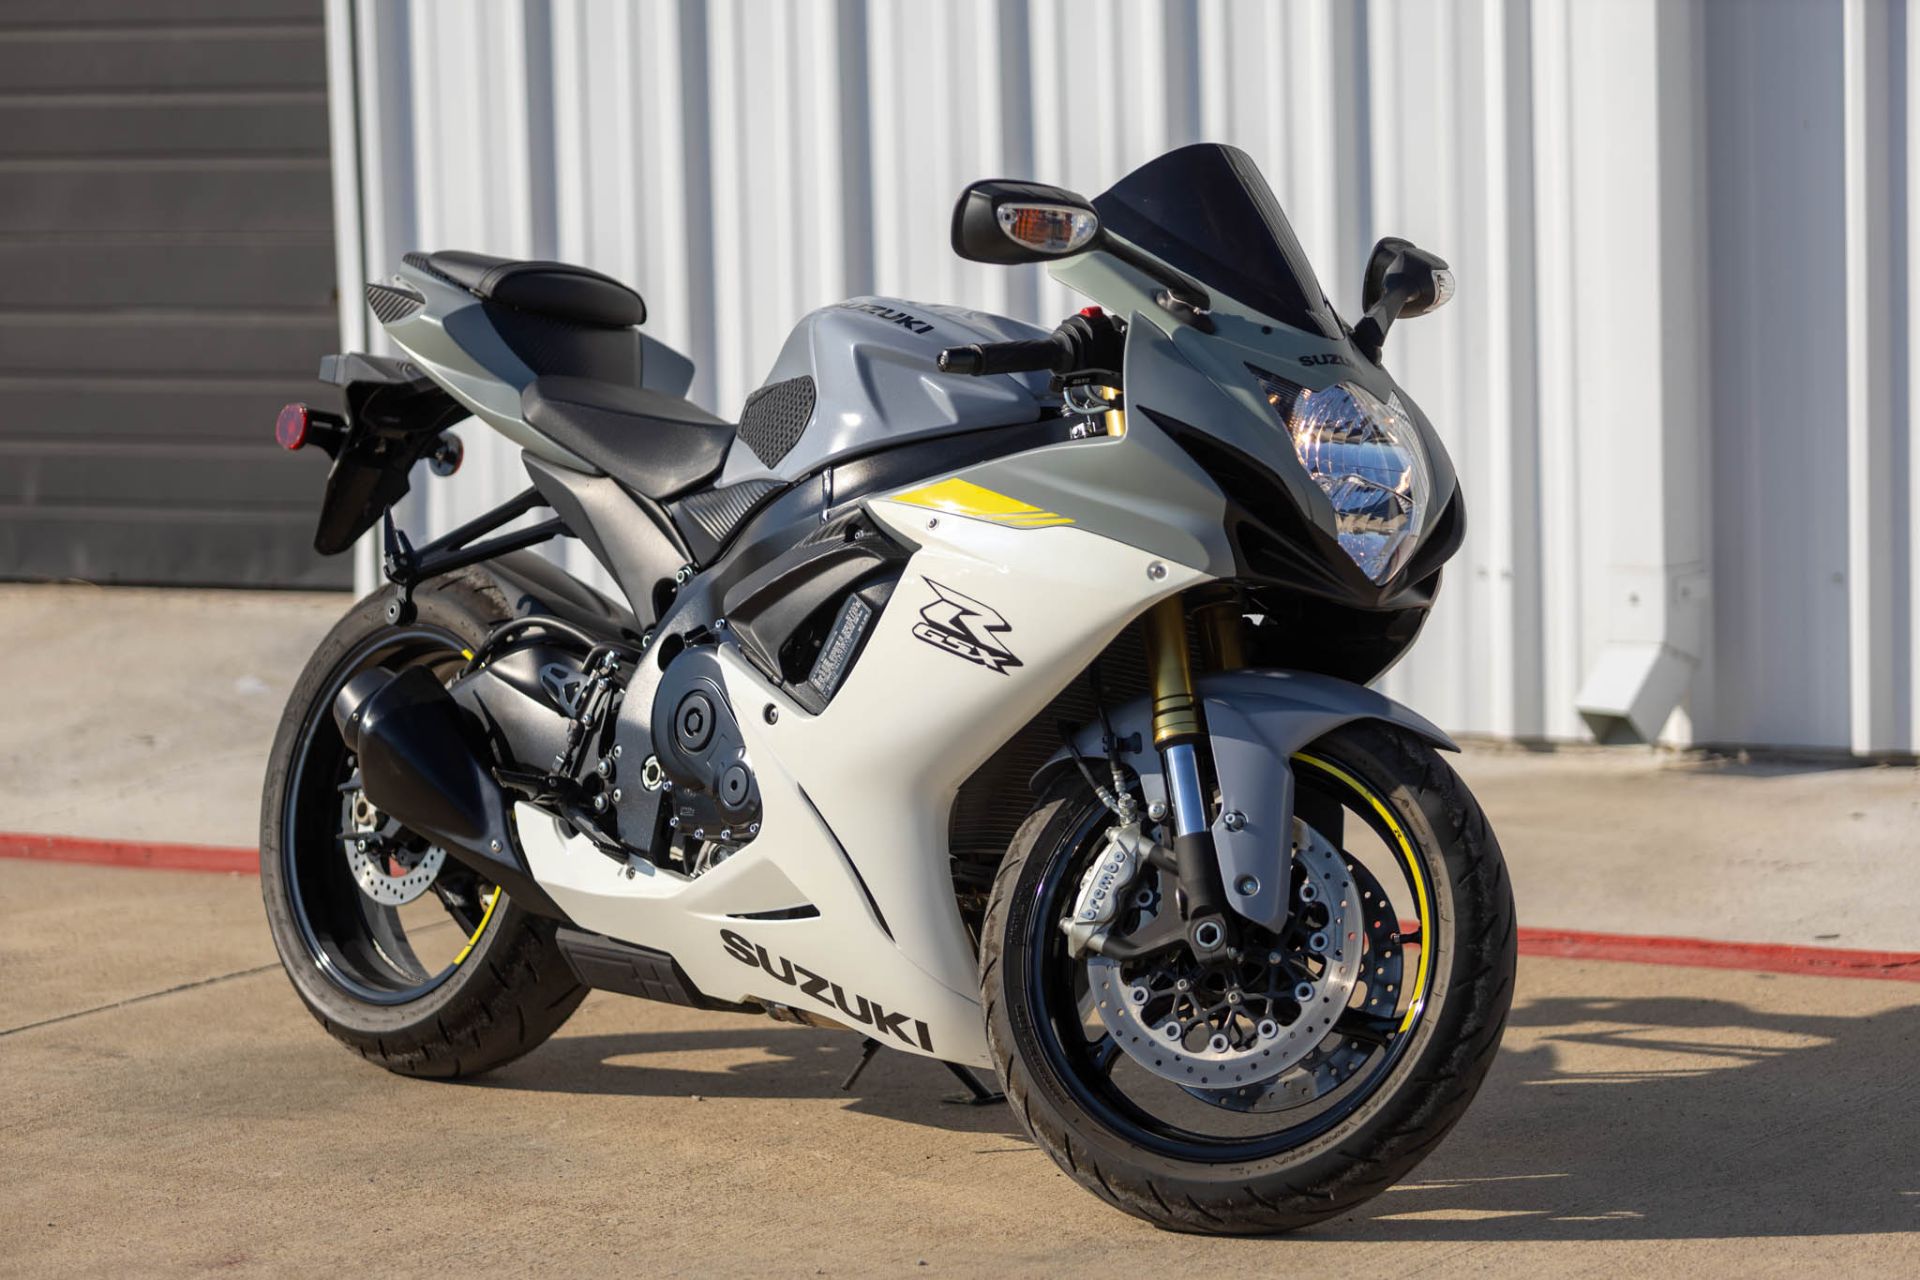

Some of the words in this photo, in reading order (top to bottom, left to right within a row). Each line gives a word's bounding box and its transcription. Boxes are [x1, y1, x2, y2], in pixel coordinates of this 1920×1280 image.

[840, 302, 935, 335] UZUKI
[1080, 850, 1127, 921] brembo
[719, 928, 935, 1053] SUZUKI
